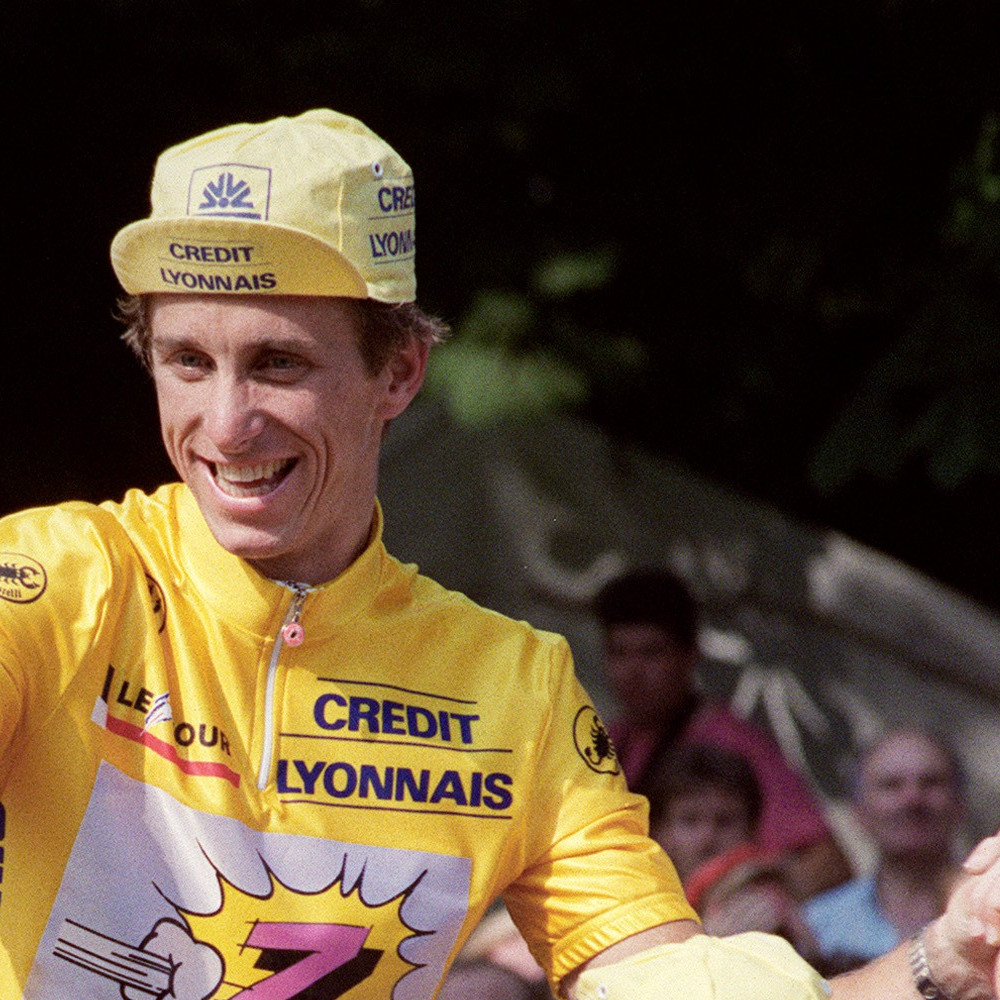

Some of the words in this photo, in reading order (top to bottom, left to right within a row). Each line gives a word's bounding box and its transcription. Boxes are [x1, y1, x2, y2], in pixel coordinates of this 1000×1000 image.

[169, 243, 254, 262] CREDIT
[160, 268, 277, 291] LYONNAIS
[116, 681, 154, 714] LE
[313, 693, 480, 744] CREDIT
[276, 759, 513, 810] LYONNAIS
